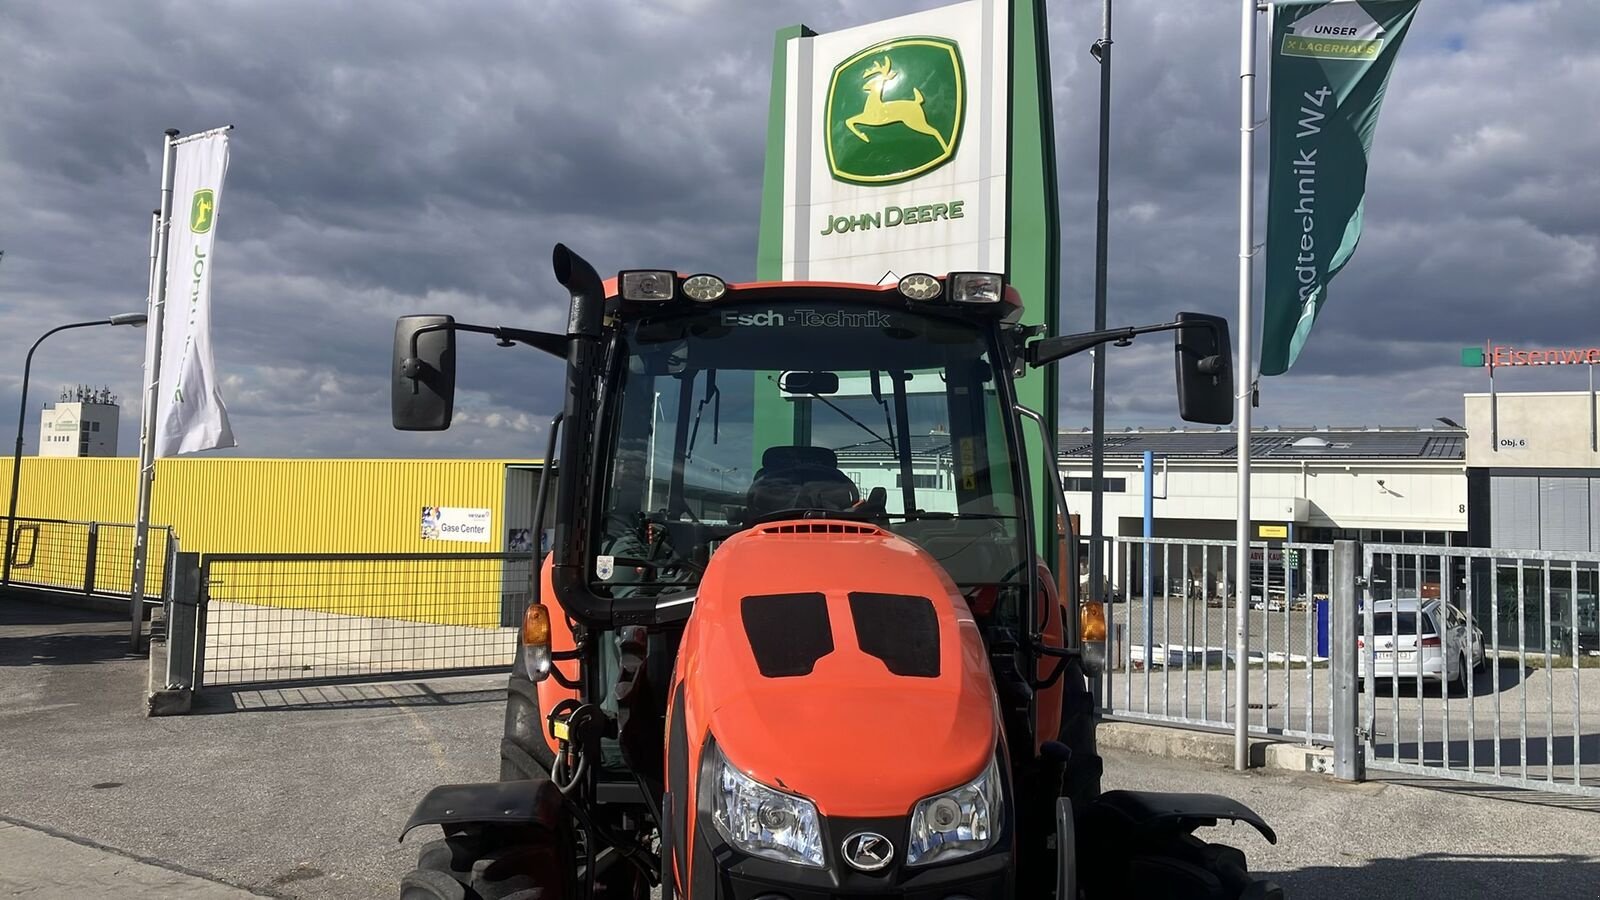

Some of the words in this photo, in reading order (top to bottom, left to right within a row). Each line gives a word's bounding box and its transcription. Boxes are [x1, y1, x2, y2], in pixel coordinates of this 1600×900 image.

[1314, 25, 1358, 36] UNSER
[1296, 86, 1333, 139] W4
[820, 211, 881, 236] JOHN
[884, 200, 964, 227] DEERE
[1500, 439, 1517, 448] Obj.
[1519, 439, 1525, 447] 6
[1458, 503, 1466, 514] 8
[441, 523, 459, 532] Gase
[461, 524, 485, 533] Center
